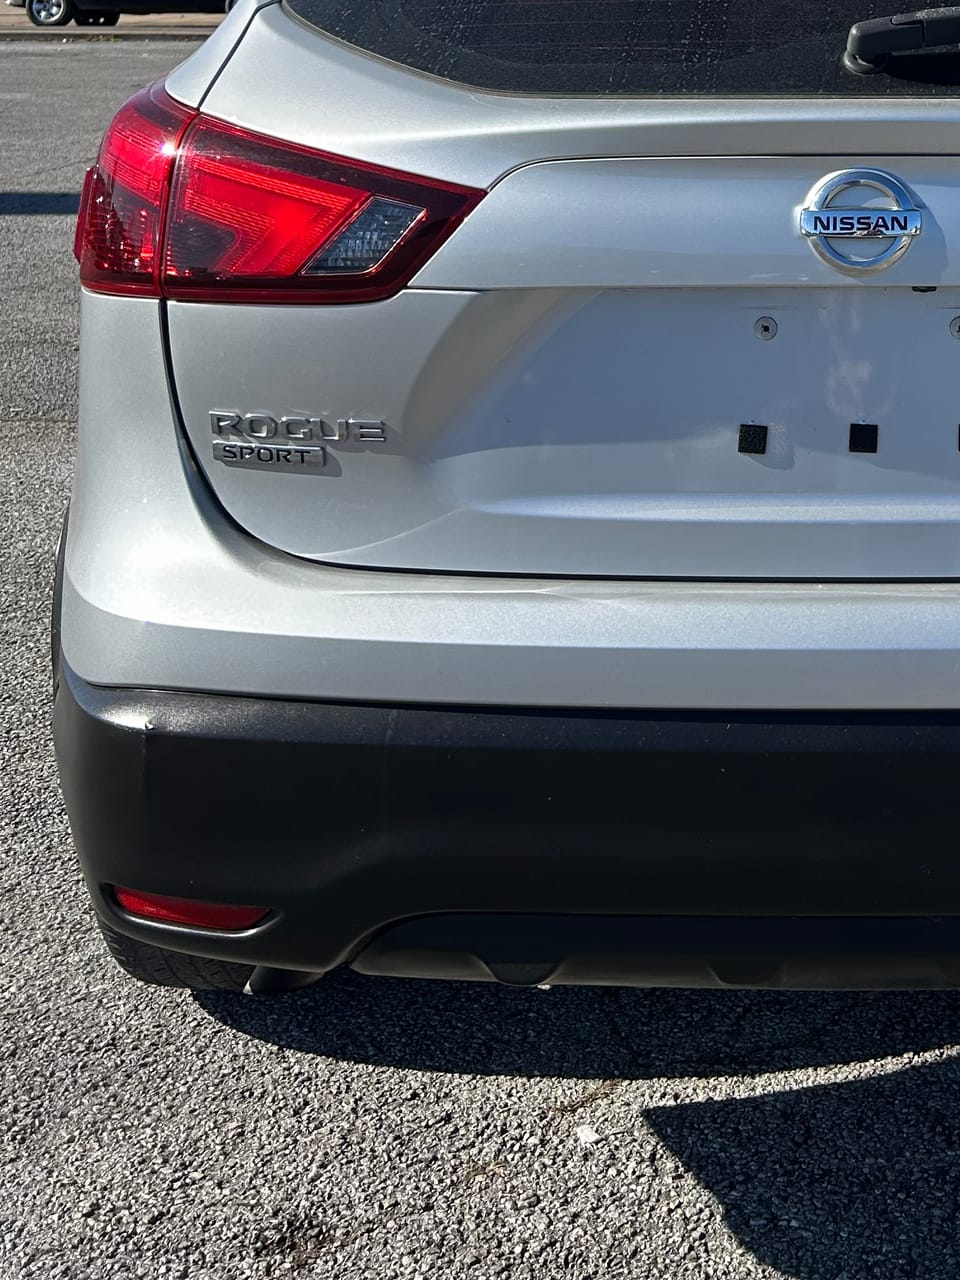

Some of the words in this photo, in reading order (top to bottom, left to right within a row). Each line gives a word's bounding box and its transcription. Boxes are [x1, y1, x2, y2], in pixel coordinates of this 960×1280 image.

[813, 215, 908, 231] NISSAN
[208, 410, 387, 442] ROGUE
[222, 444, 311, 464] SPORT
